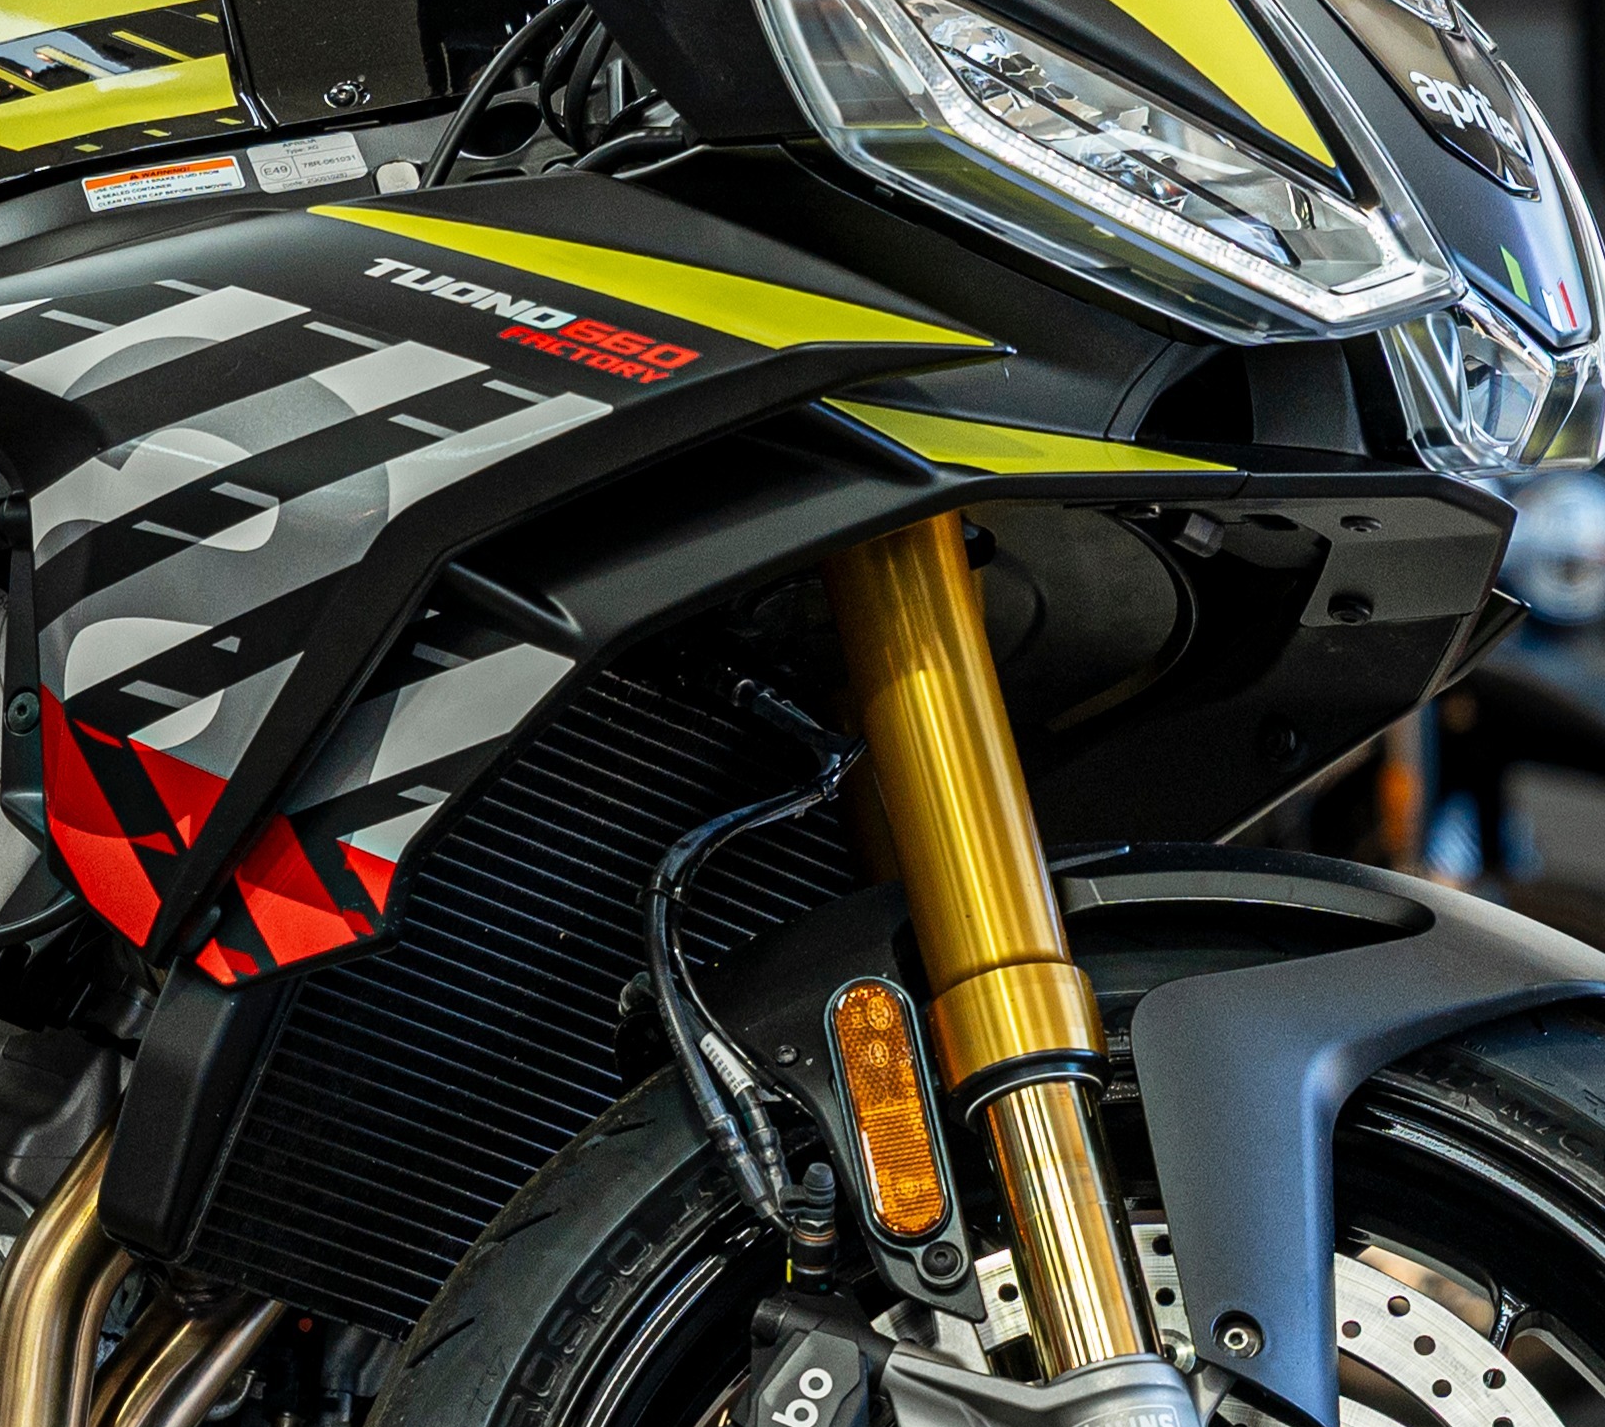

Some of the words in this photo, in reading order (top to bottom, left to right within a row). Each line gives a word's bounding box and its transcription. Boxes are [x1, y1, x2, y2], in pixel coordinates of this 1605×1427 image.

[1409, 71, 1533, 165] aprilia
[141, 166, 190, 179] WARNING!
[263, 165, 288, 176] E49
[151, 175, 176, 184] BRAKE
[131, 183, 172, 195] CONTAINER
[195, 181, 233, 192] REMOVING
[364, 258, 578, 330] TUONO
[558, 318, 703, 370] 660
[496, 325, 671, 384] FACTORY
